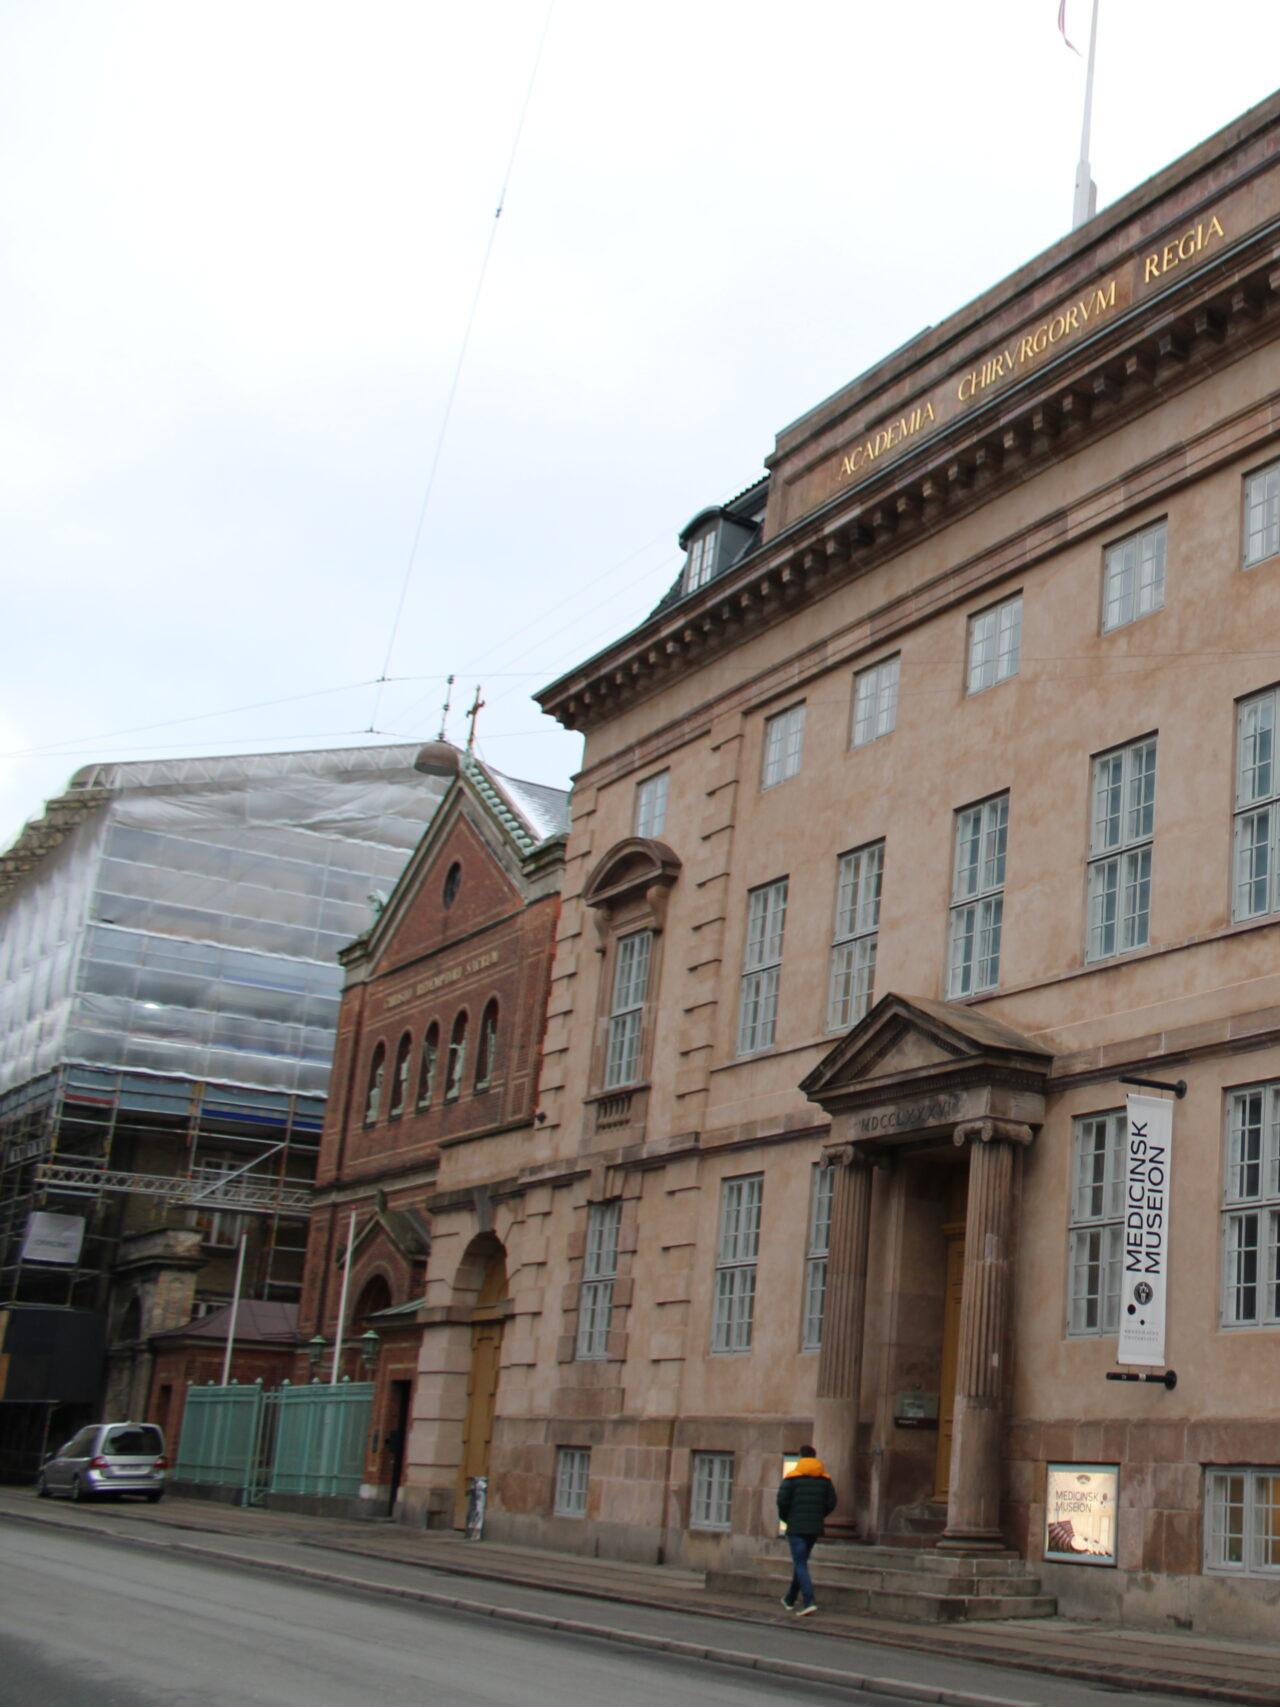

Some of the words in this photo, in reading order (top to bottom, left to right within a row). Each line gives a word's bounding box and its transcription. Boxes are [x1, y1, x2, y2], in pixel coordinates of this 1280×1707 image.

[838, 401, 936, 480] ACADEMIA
[957, 280, 1117, 401] CHIRVRGORVM
[1144, 215, 1225, 283] REGIA
[1126, 1121, 1148, 1272] MEDICINSK
[1145, 1146, 1165, 1274] MUSEION
[1055, 1490, 1099, 1502] MEDICINSK
[1055, 1501, 1092, 1513] MUSEION
